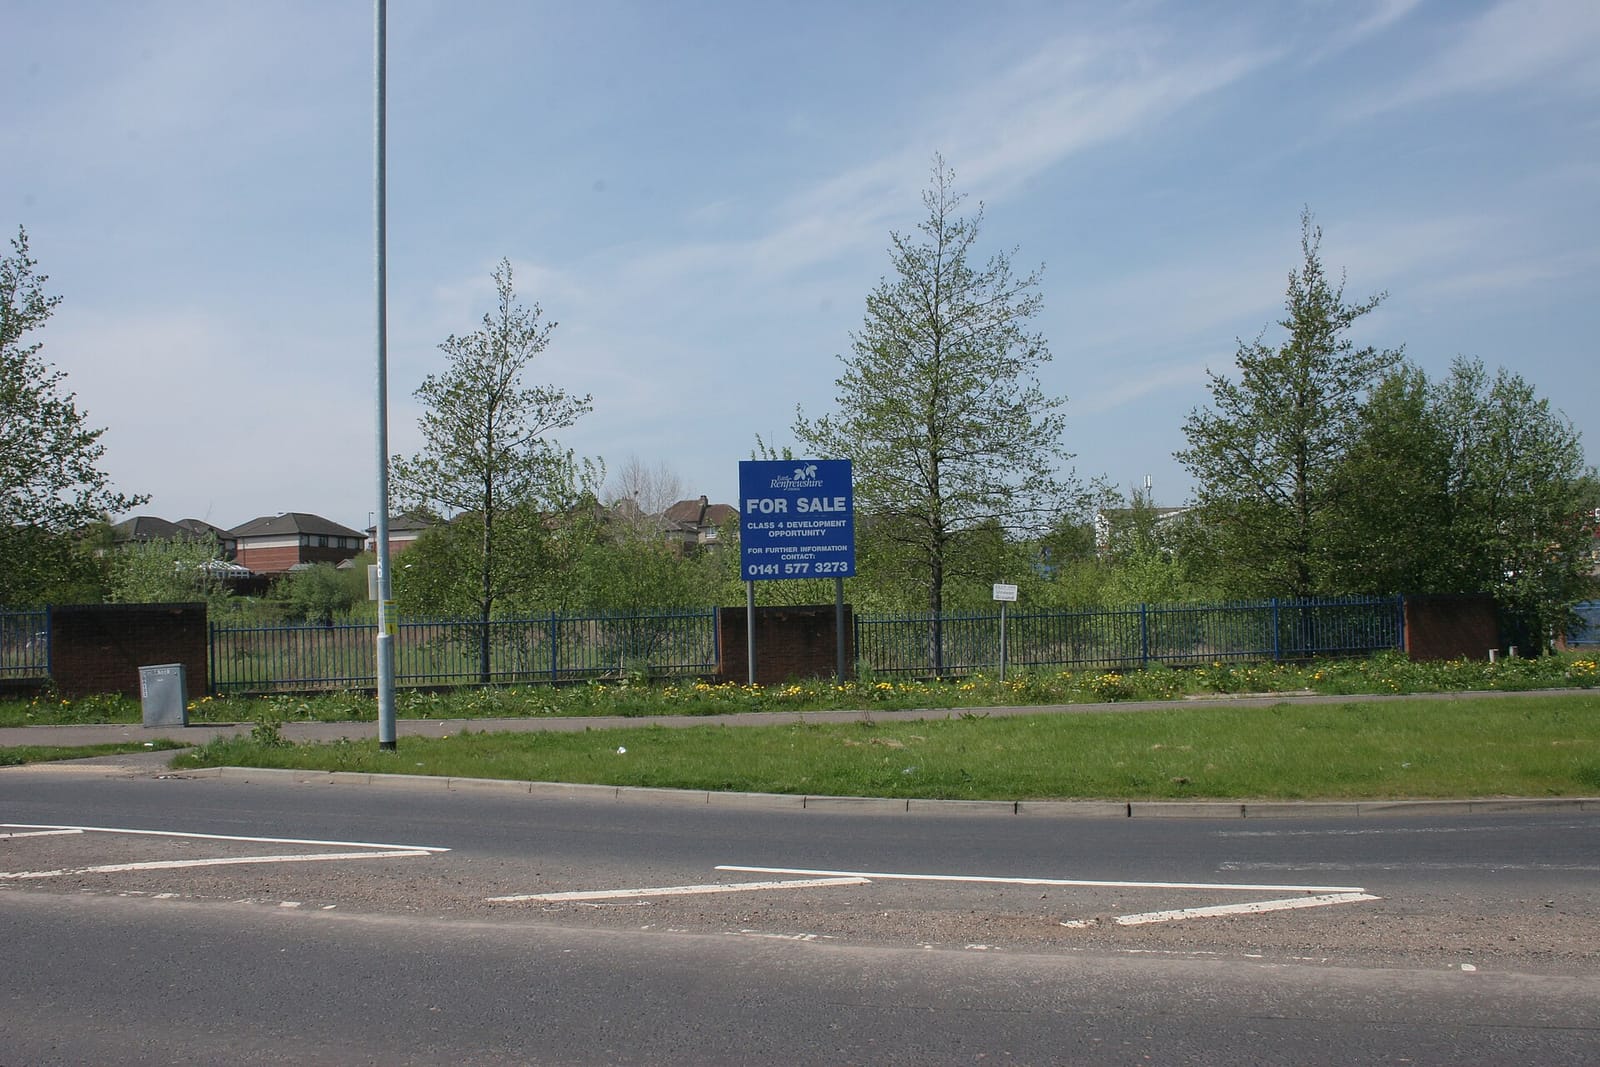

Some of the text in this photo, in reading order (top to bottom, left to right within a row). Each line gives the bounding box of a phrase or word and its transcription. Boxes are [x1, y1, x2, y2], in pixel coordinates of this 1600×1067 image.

[770, 479, 823, 490] Renfrewshire
[747, 497, 846, 514] FOR SALE
[748, 562, 848, 575] 0141 577 3273
